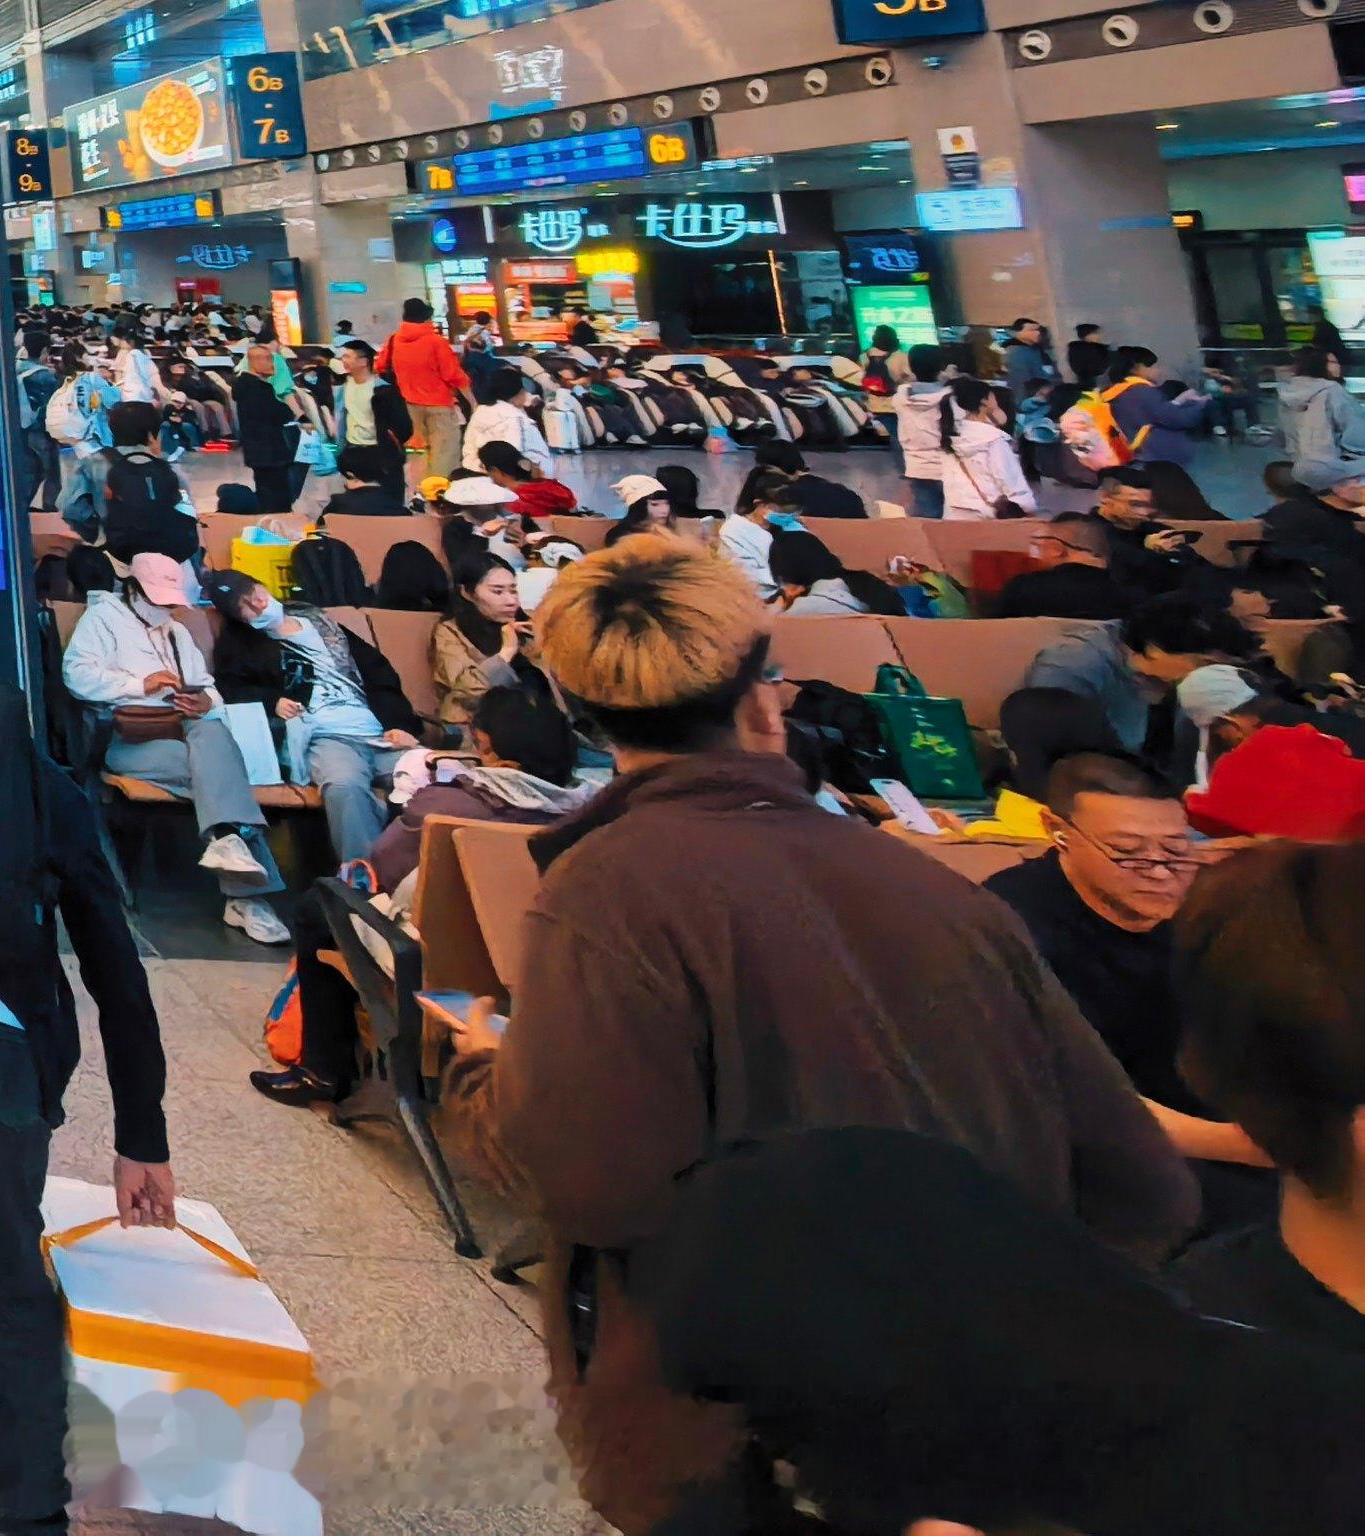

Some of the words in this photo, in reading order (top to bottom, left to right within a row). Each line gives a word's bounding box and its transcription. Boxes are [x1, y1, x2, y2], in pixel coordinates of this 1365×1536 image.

[248, 67, 284, 92] 6B
[253, 119, 291, 144] 7B
[16, 138, 38, 156] 8B
[648, 133, 687, 163] 6B
[19, 174, 41, 191] 9B
